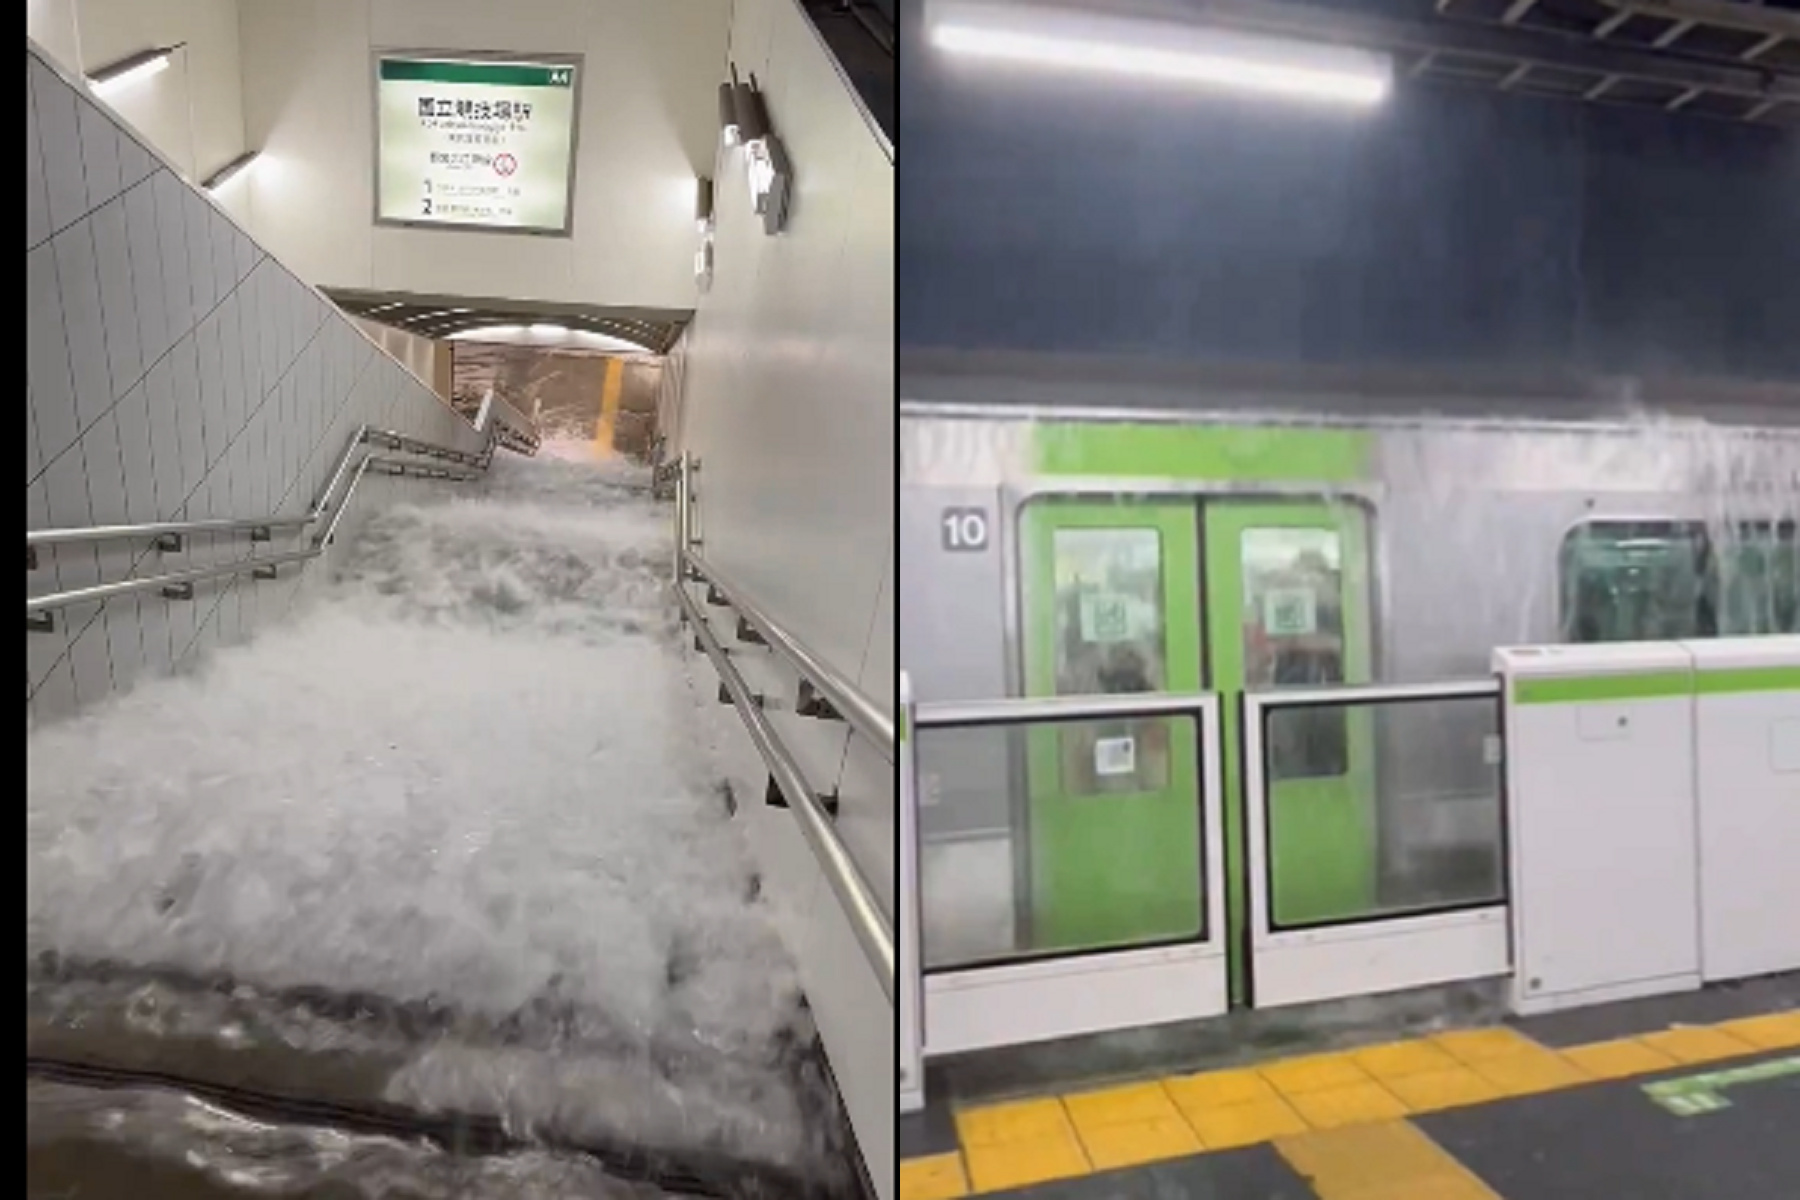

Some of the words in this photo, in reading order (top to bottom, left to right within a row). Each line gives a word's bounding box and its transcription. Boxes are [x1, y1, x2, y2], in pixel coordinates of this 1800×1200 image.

[423, 179, 432, 194] 1
[422, 198, 432, 215] 2
[944, 513, 985, 546] 10
